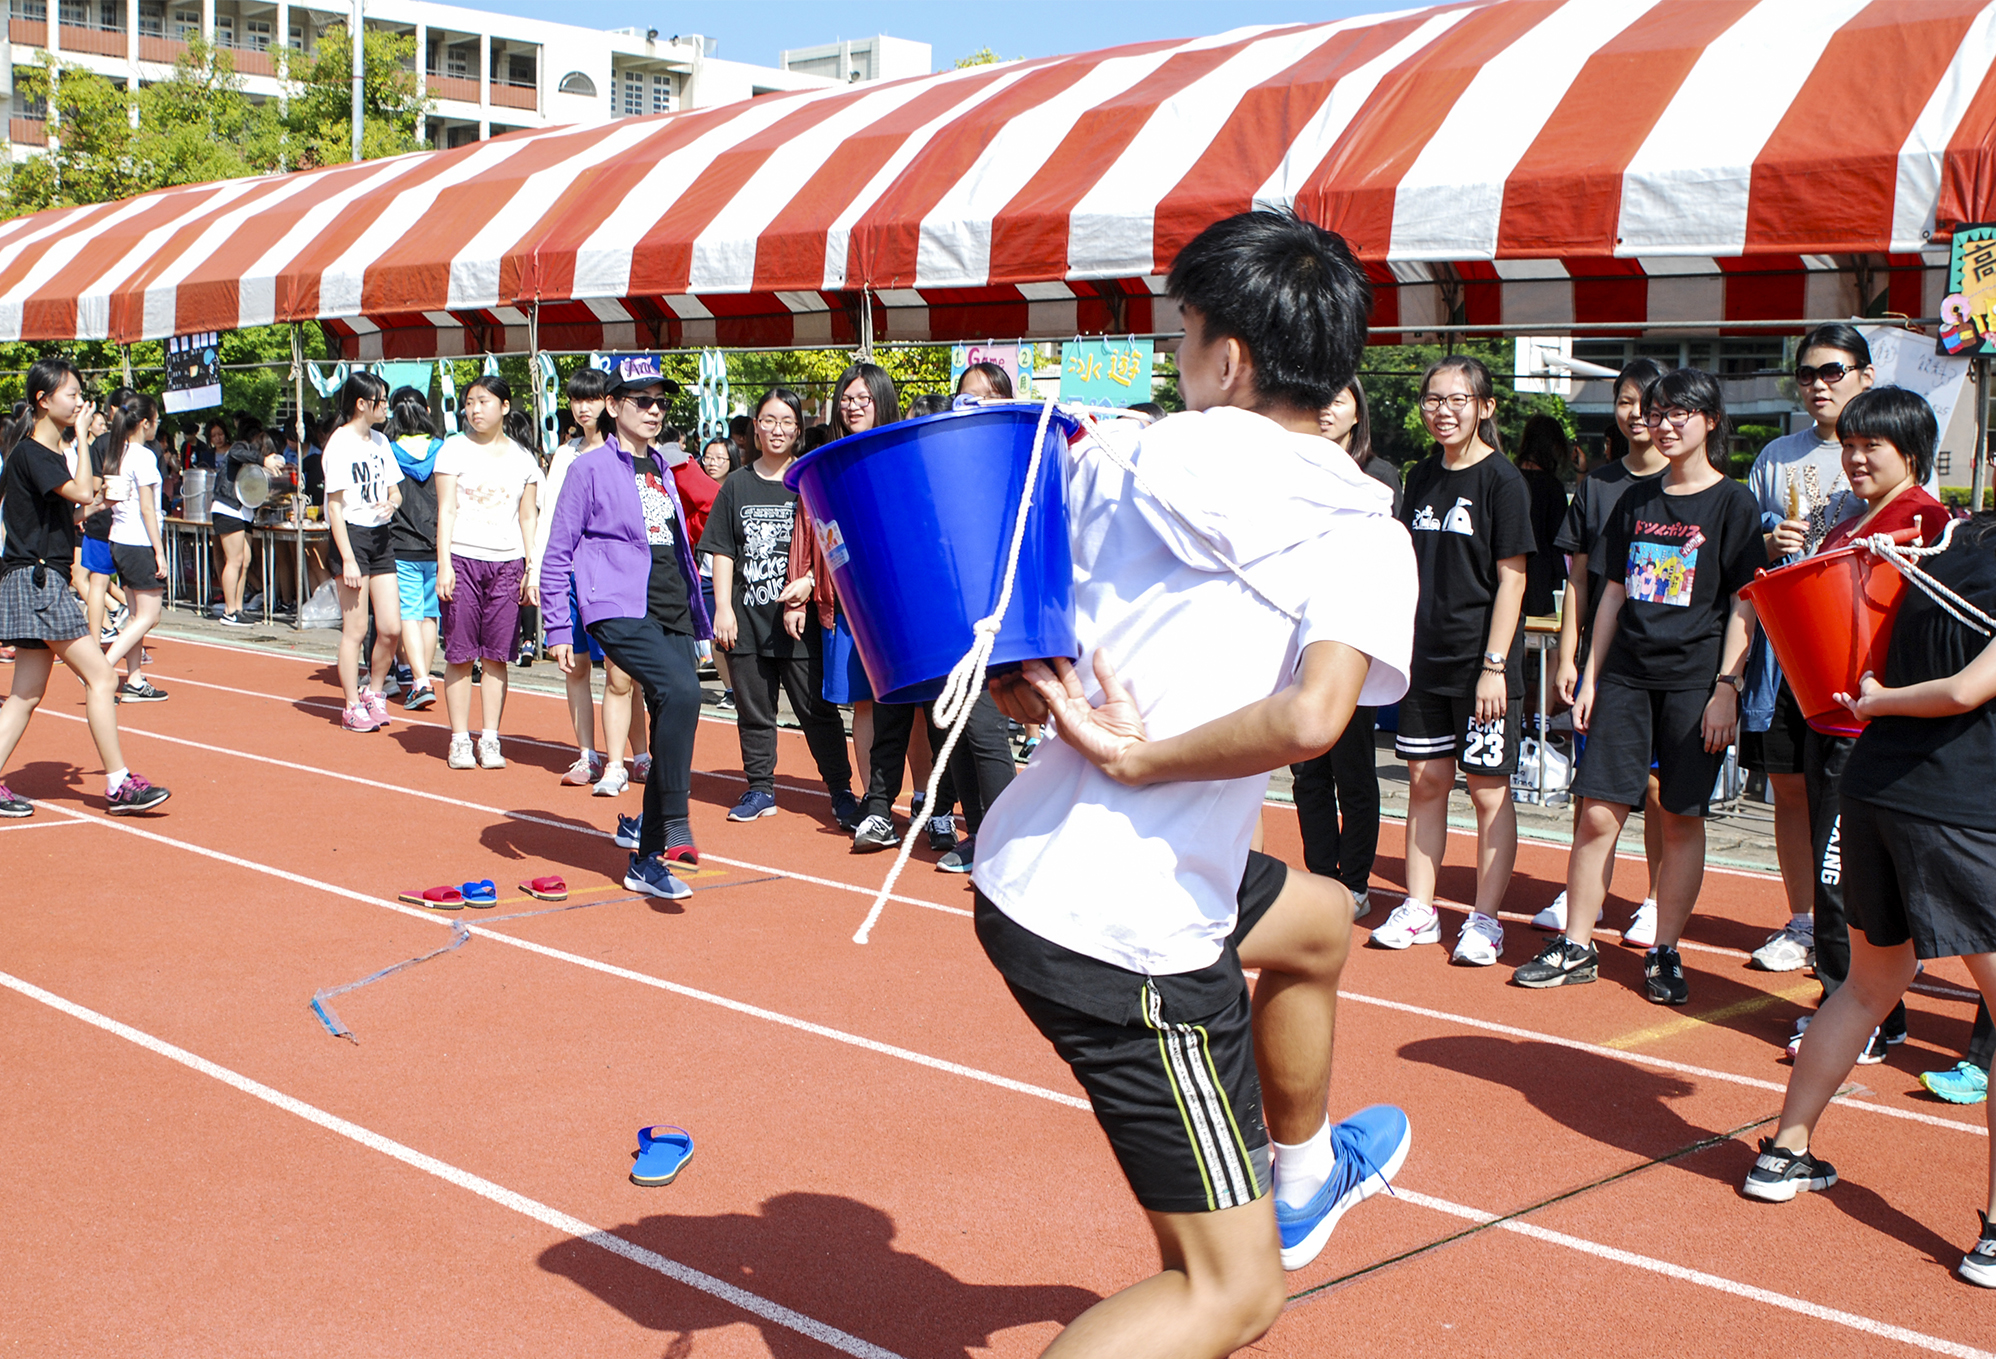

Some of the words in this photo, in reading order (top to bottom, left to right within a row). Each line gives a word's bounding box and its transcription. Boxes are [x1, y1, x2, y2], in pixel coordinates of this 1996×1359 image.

[1021, 351, 1028, 365] 2
[743, 557, 788, 584] MICKE
[1463, 731, 1505, 767] 23
[1756, 1153, 1790, 1174] NIKE
